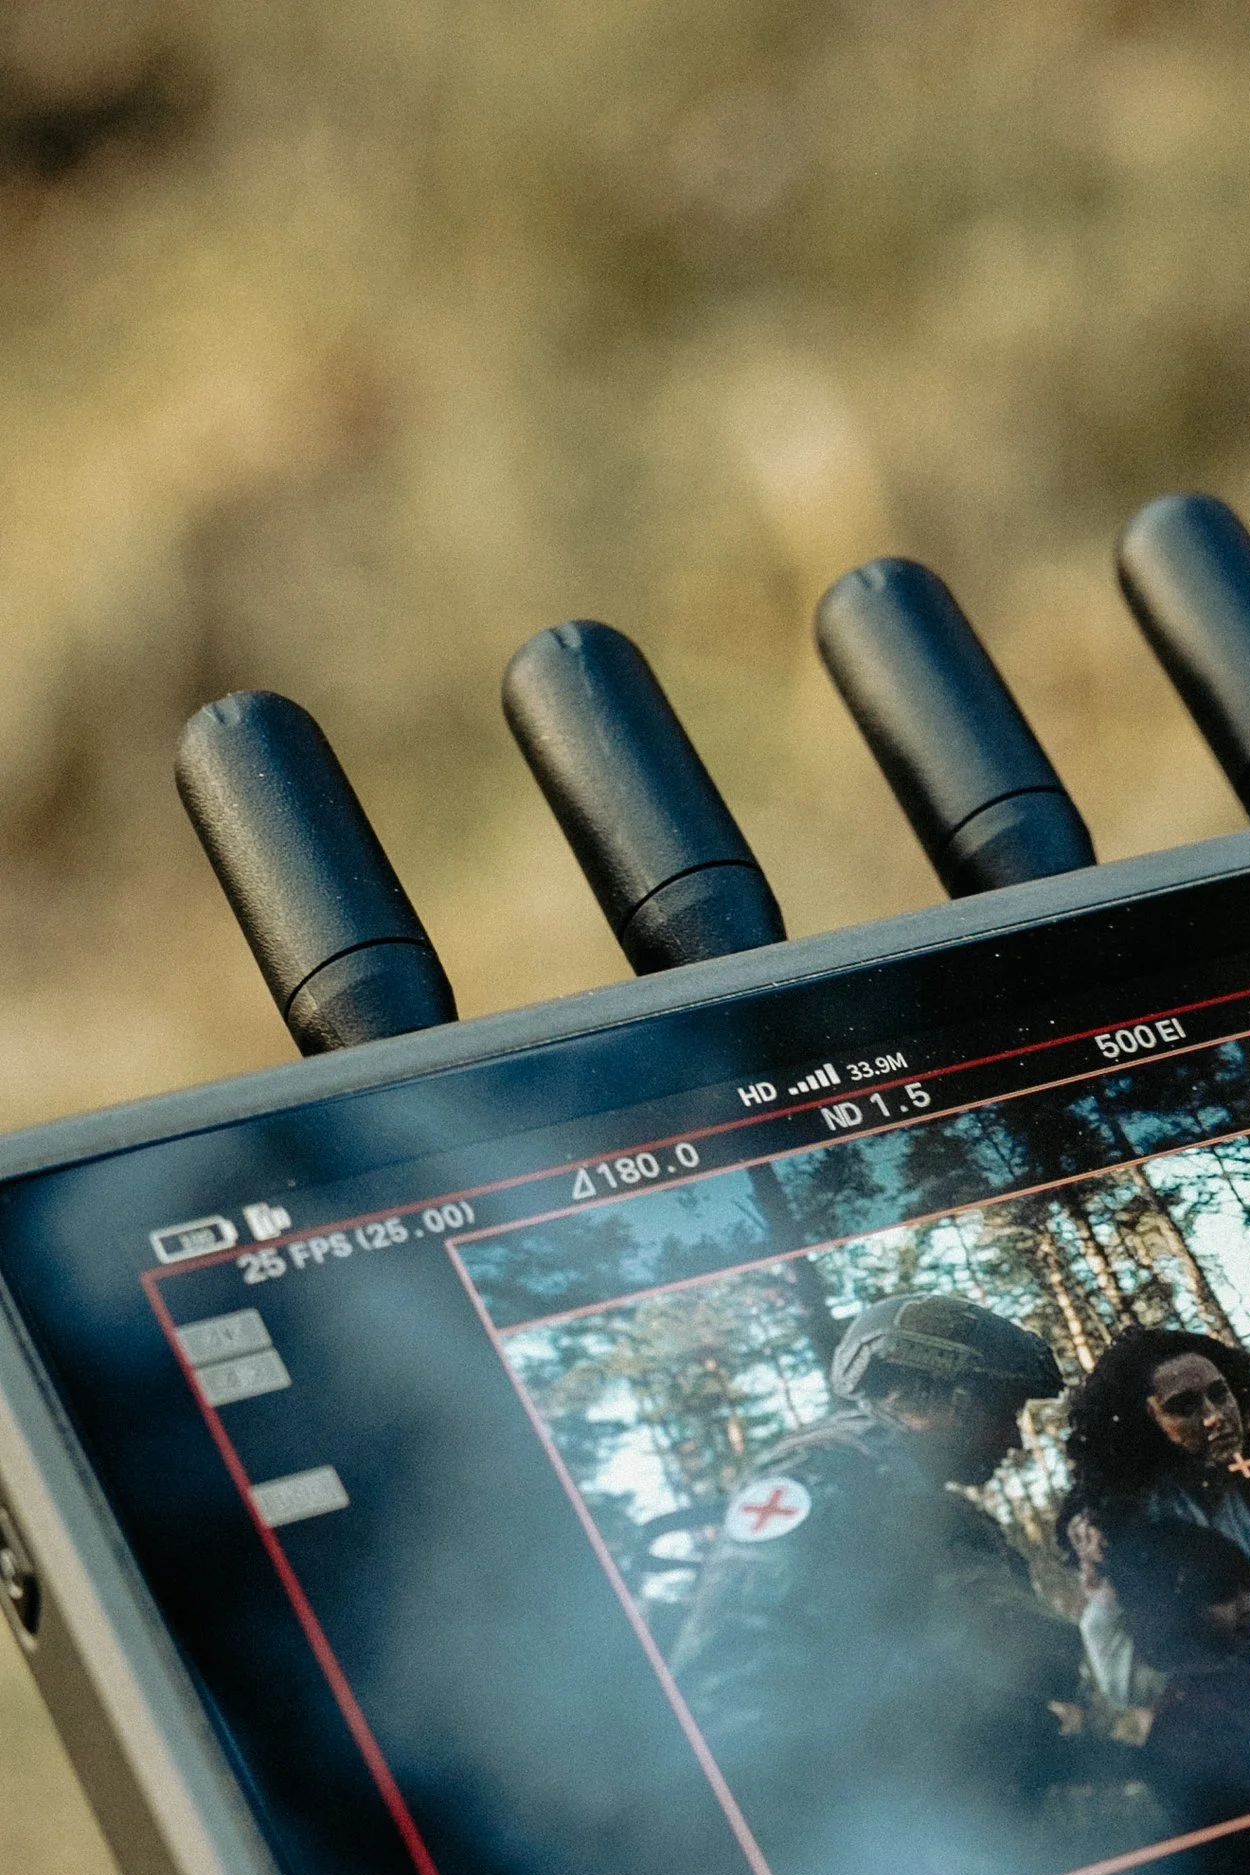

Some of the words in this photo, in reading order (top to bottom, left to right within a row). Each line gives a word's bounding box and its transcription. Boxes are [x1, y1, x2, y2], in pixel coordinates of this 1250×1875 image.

[737, 1081, 779, 1107] HD
[846, 1051, 909, 1083] 33.9M
[819, 1101, 864, 1132] ND
[869, 1081, 932, 1118] 1.5
[236, 1246, 288, 1286] 25
[286, 1230, 354, 1270] FPS
